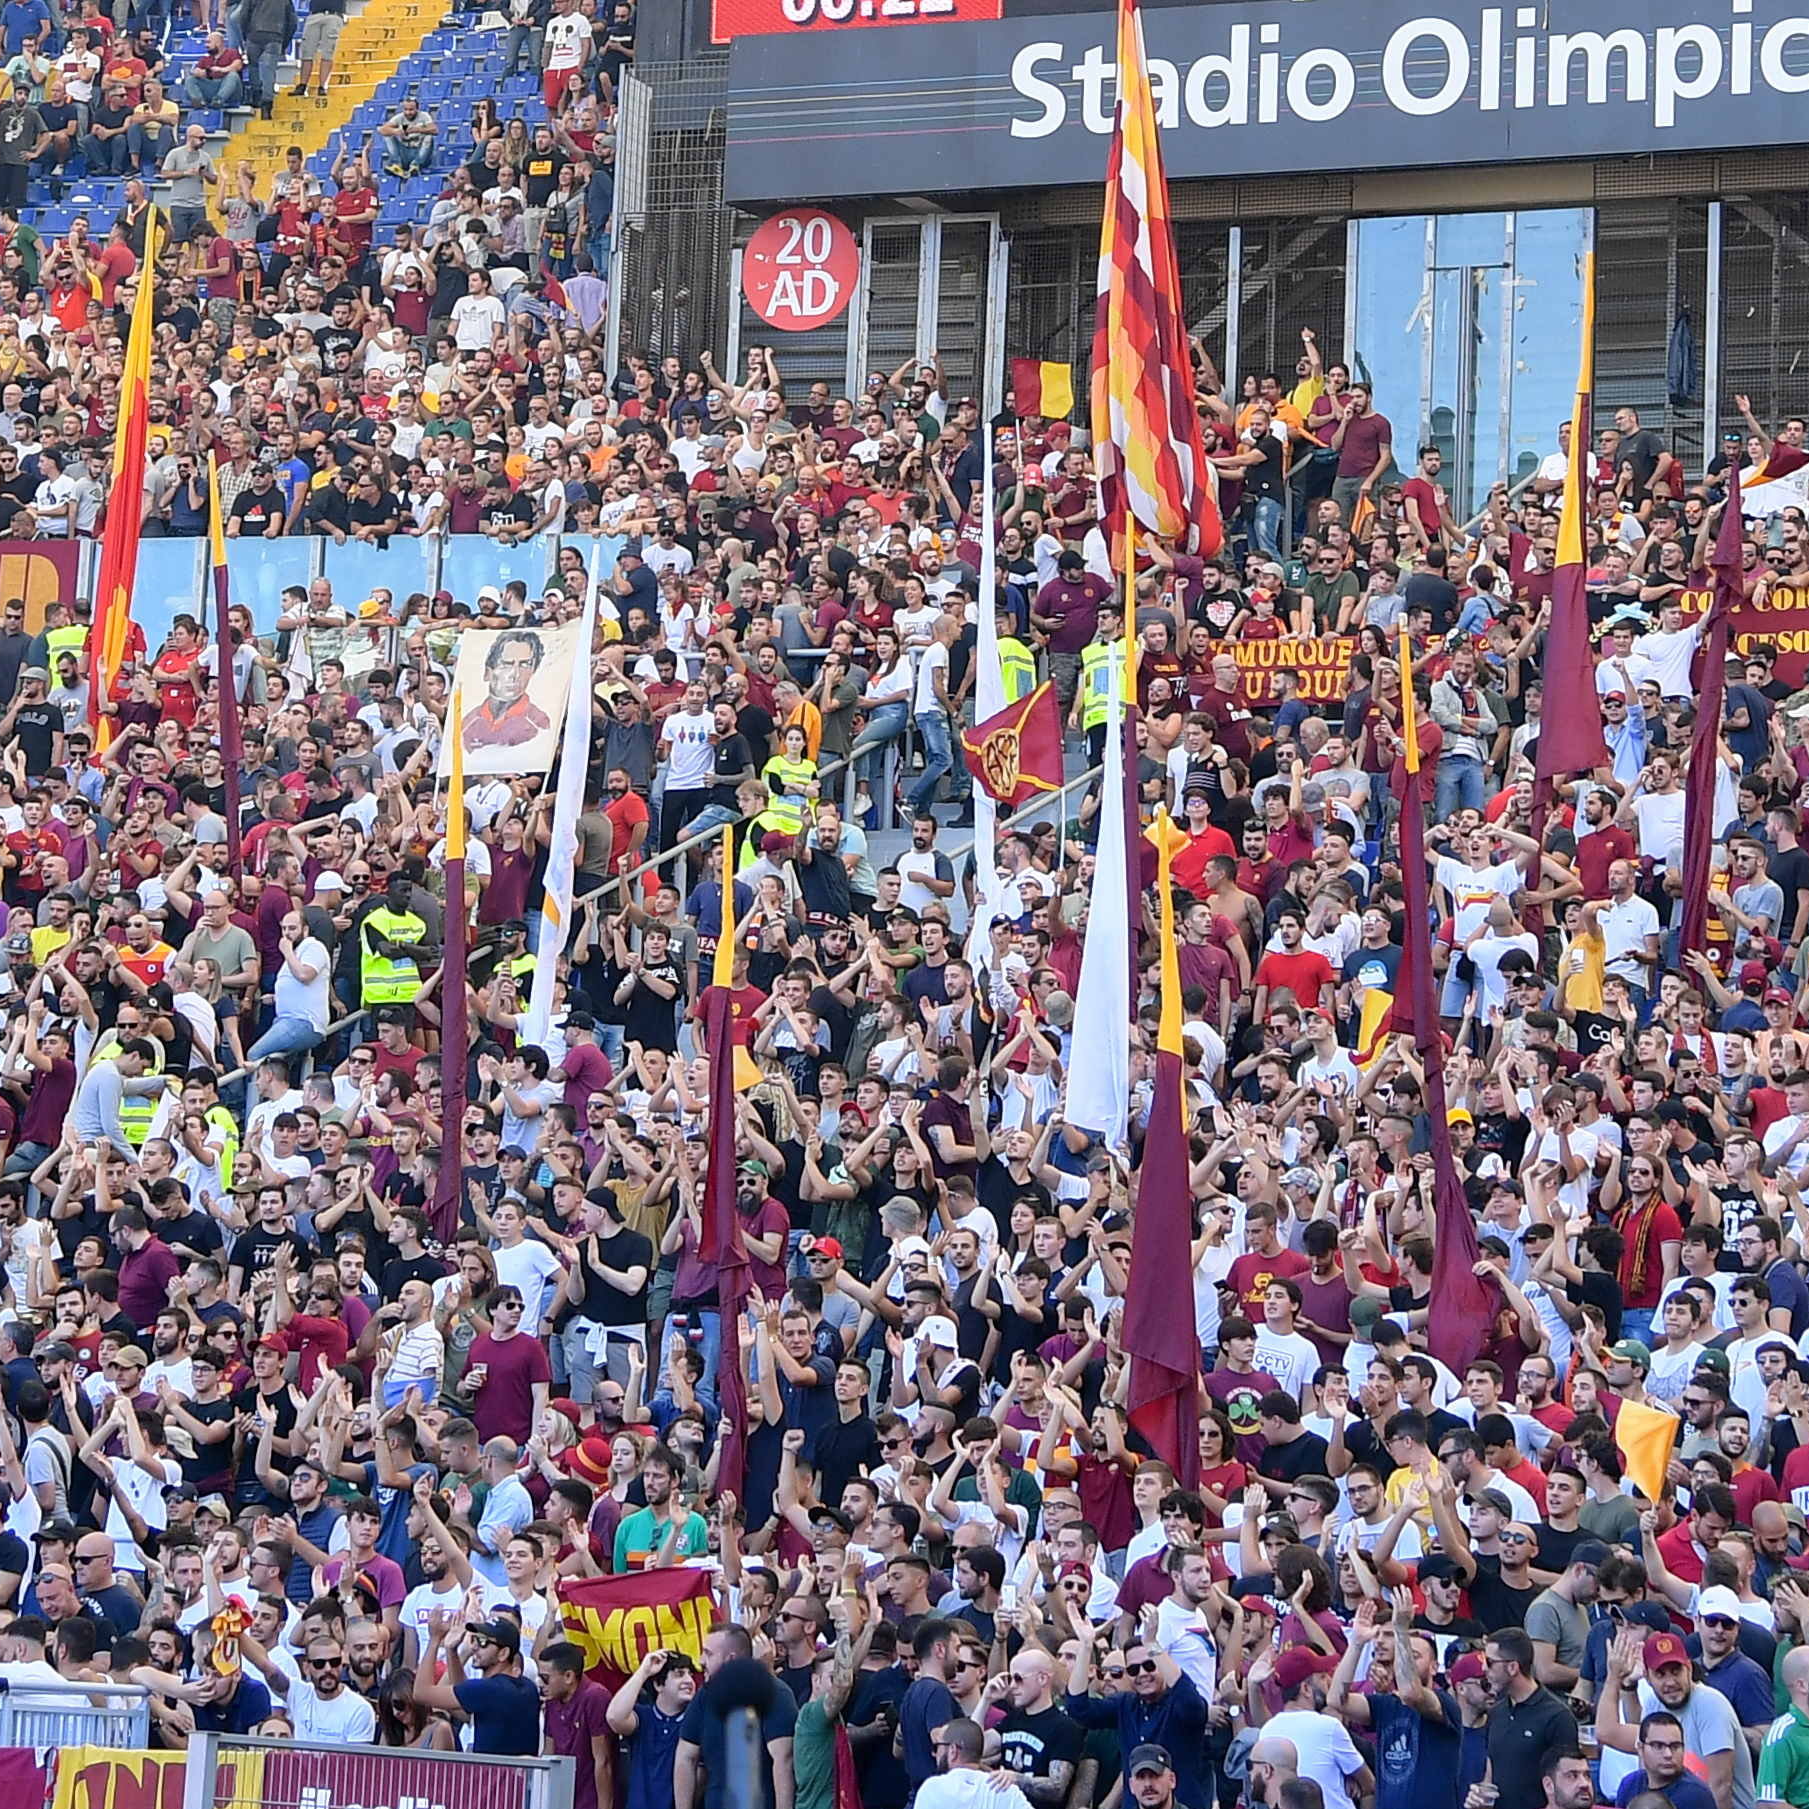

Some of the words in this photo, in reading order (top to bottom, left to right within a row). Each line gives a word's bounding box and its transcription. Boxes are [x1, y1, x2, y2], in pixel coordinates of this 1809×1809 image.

[776, 217, 833, 264] 20
[766, 267, 836, 317] AD
[1255, 1353, 1290, 1370] CCTV
